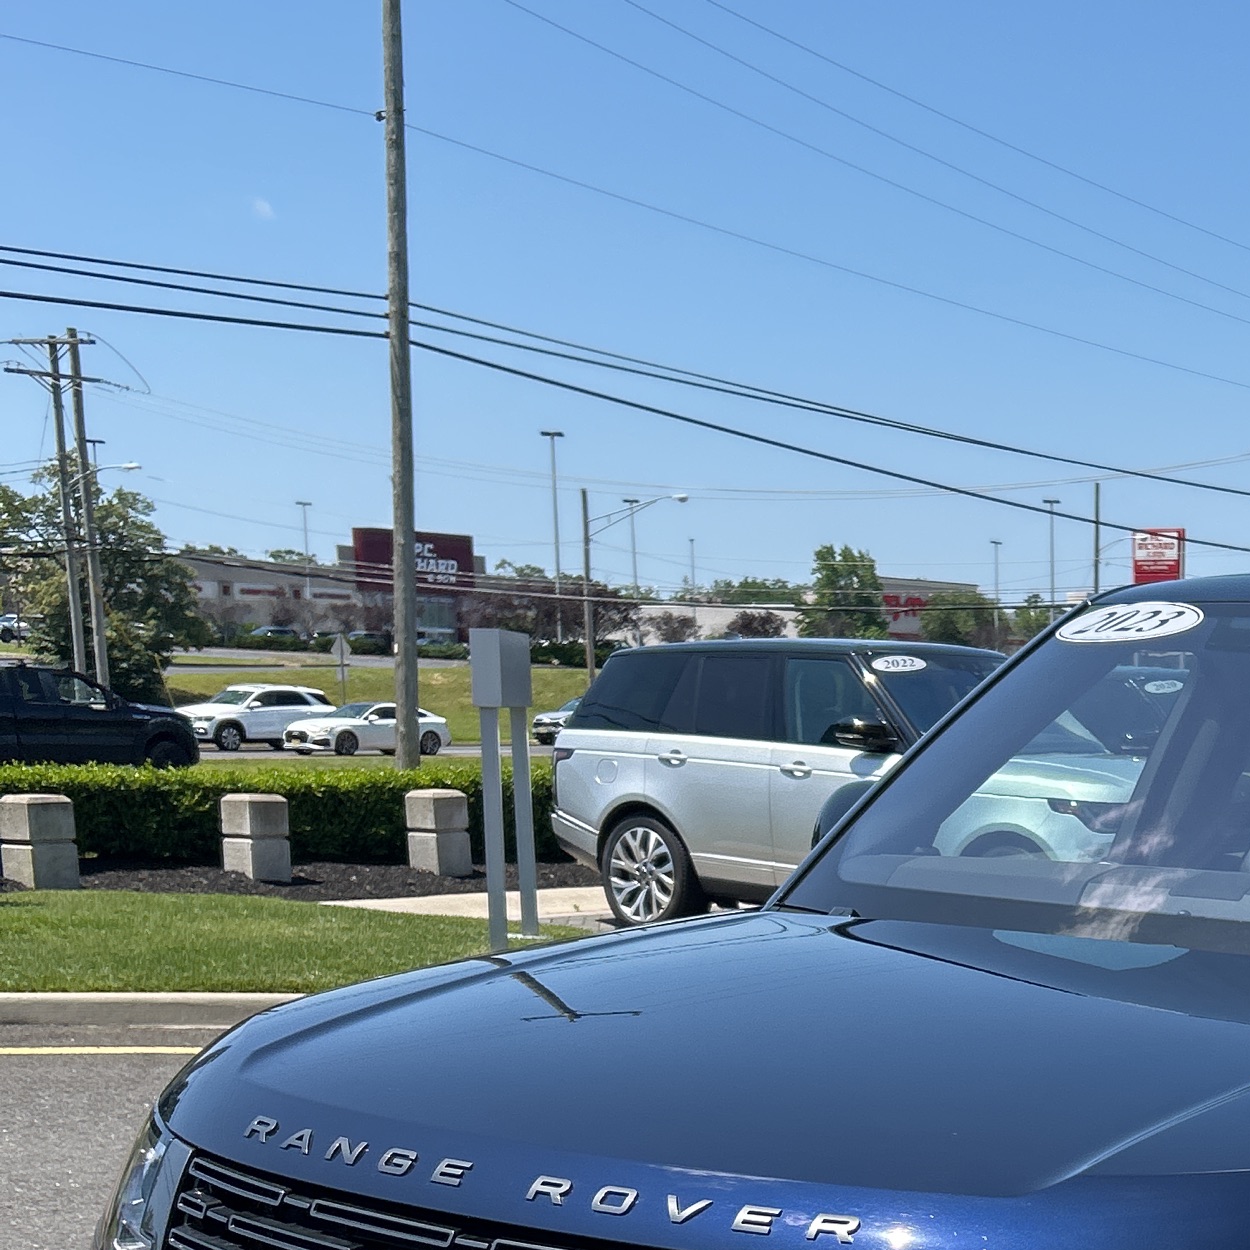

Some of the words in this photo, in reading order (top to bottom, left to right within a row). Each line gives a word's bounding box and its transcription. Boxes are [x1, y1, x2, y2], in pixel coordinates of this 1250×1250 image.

[415, 558, 458, 574] HARD
[1069, 609, 1186, 635] 2023
[883, 658, 917, 670] 2022
[243, 1115, 473, 1186] RANGE
[525, 1174, 862, 1244] ROVER
